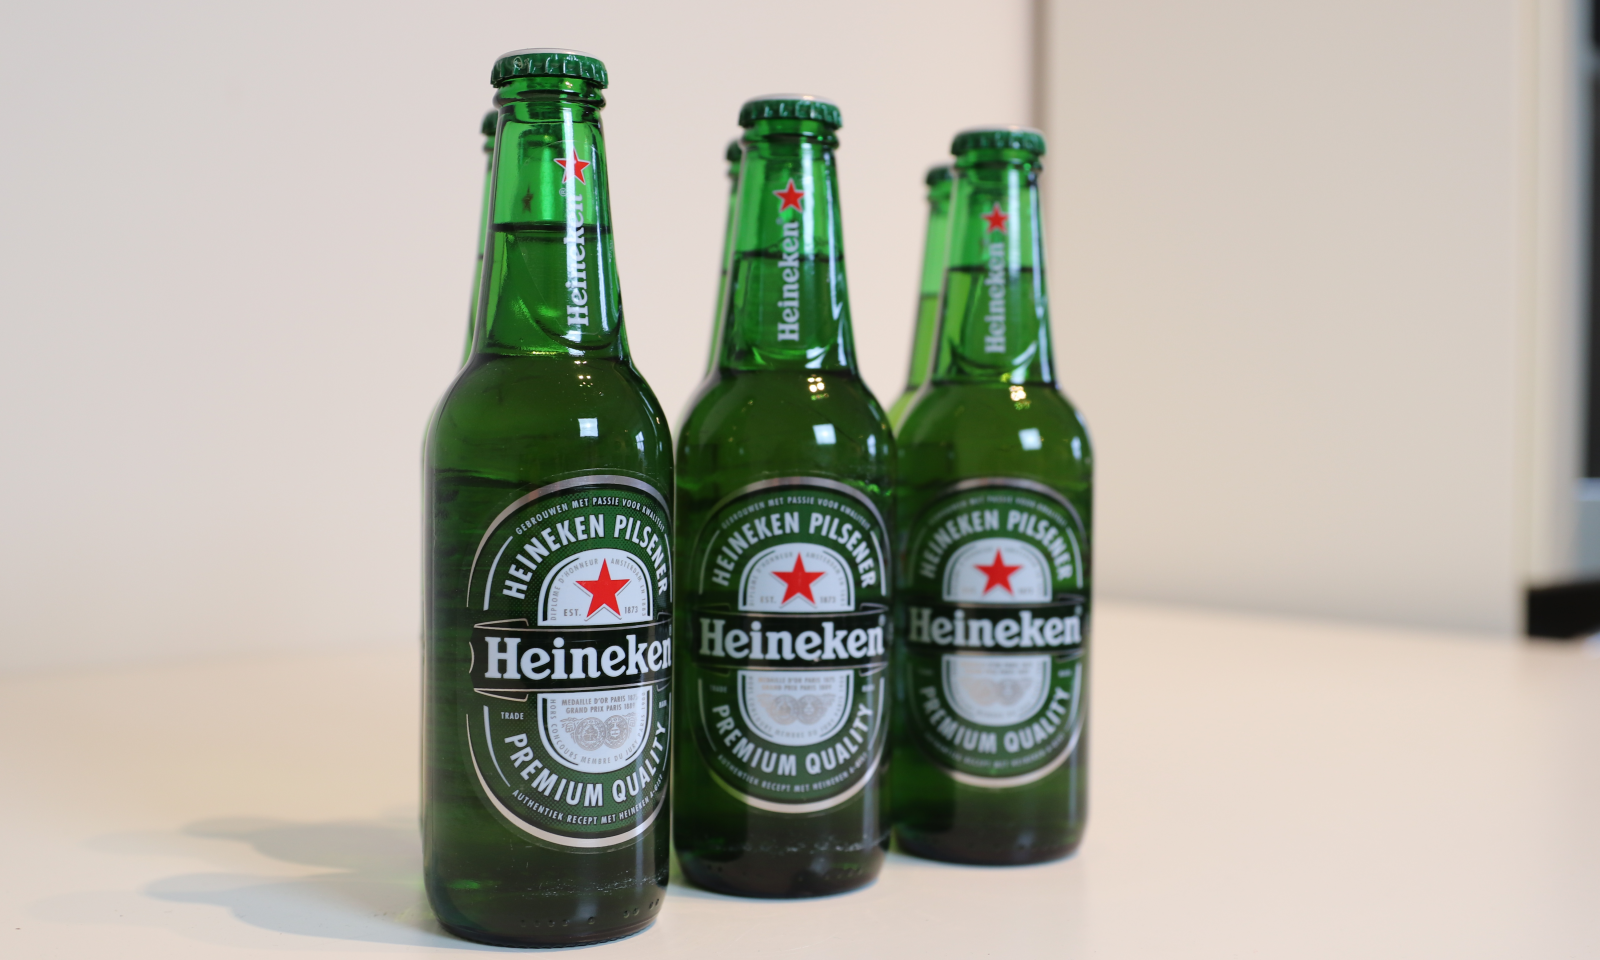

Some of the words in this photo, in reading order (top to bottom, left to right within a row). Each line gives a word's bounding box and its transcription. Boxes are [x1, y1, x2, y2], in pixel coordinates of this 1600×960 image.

[563, 193, 590, 327] Heineken
[777, 221, 800, 342] Heineken
[984, 242, 1007, 354] Heineken
[515, 502, 569, 535] GEBROUWEN
[571, 498, 589, 509] MET
[593, 496, 619, 506] PASSIE
[622, 497, 641, 511] VOOR
[787, 495, 815, 504] PASSIE
[503, 514, 605, 600] HEINEKEN
[613, 514, 668, 596] PILSENER
[711, 511, 800, 587] HEINEKEN
[809, 512, 877, 589] PILSENER
[919, 509, 1000, 580] HEINEKEN
[1007, 509, 1073, 582] PILSENER
[563, 608, 582, 617] EST.
[624, 605, 639, 614] 1873
[908, 606, 1082, 649] Heineken
[484, 633, 671, 680] Heineken
[699, 617, 885, 661] Heineken
[500, 711, 525, 720] TRADE
[561, 698, 592, 706] MEDAILLE
[610, 695, 626, 703] PARIS
[565, 706, 588, 714] GRAND
[590, 705, 604, 713] PRIX
[606, 703, 622, 712] PARIS
[919, 685, 997, 755] PREMIUM
[1003, 685, 1071, 754] QUALITY
[711, 704, 797, 777] PREMIUM
[805, 703, 873, 776] QUALITY
[504, 732, 604, 808] PREMIUM
[612, 721, 667, 803] QUALITY
[511, 789, 564, 821] AUTHENTIEK
[566, 814, 598, 825] RECEPT
[600, 813, 617, 824] MET
[619, 796, 649, 821] HEINEKEN
